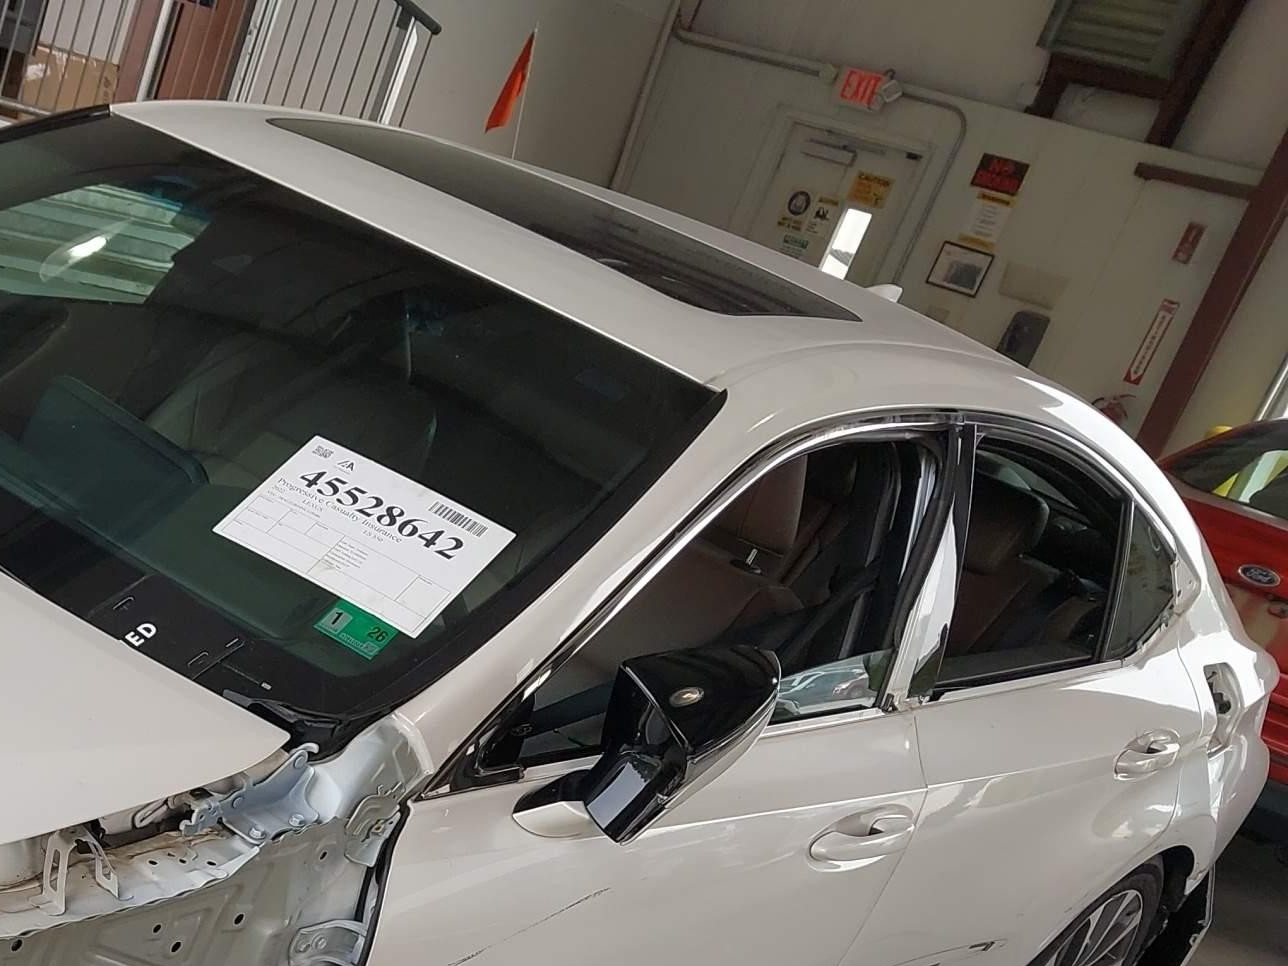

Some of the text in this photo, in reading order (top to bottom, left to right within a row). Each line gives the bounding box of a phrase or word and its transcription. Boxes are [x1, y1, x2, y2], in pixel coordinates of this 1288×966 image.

[840, 69, 883, 107] EXIT
[278, 477, 325, 504] Progressive
[326, 500, 359, 522] Casualty
[362, 519, 402, 544] Insurance
[300, 471, 464, 560] 45528642
[125, 622, 158, 647] ED
[331, 611, 344, 625] 1
[367, 626, 389, 643] 26
